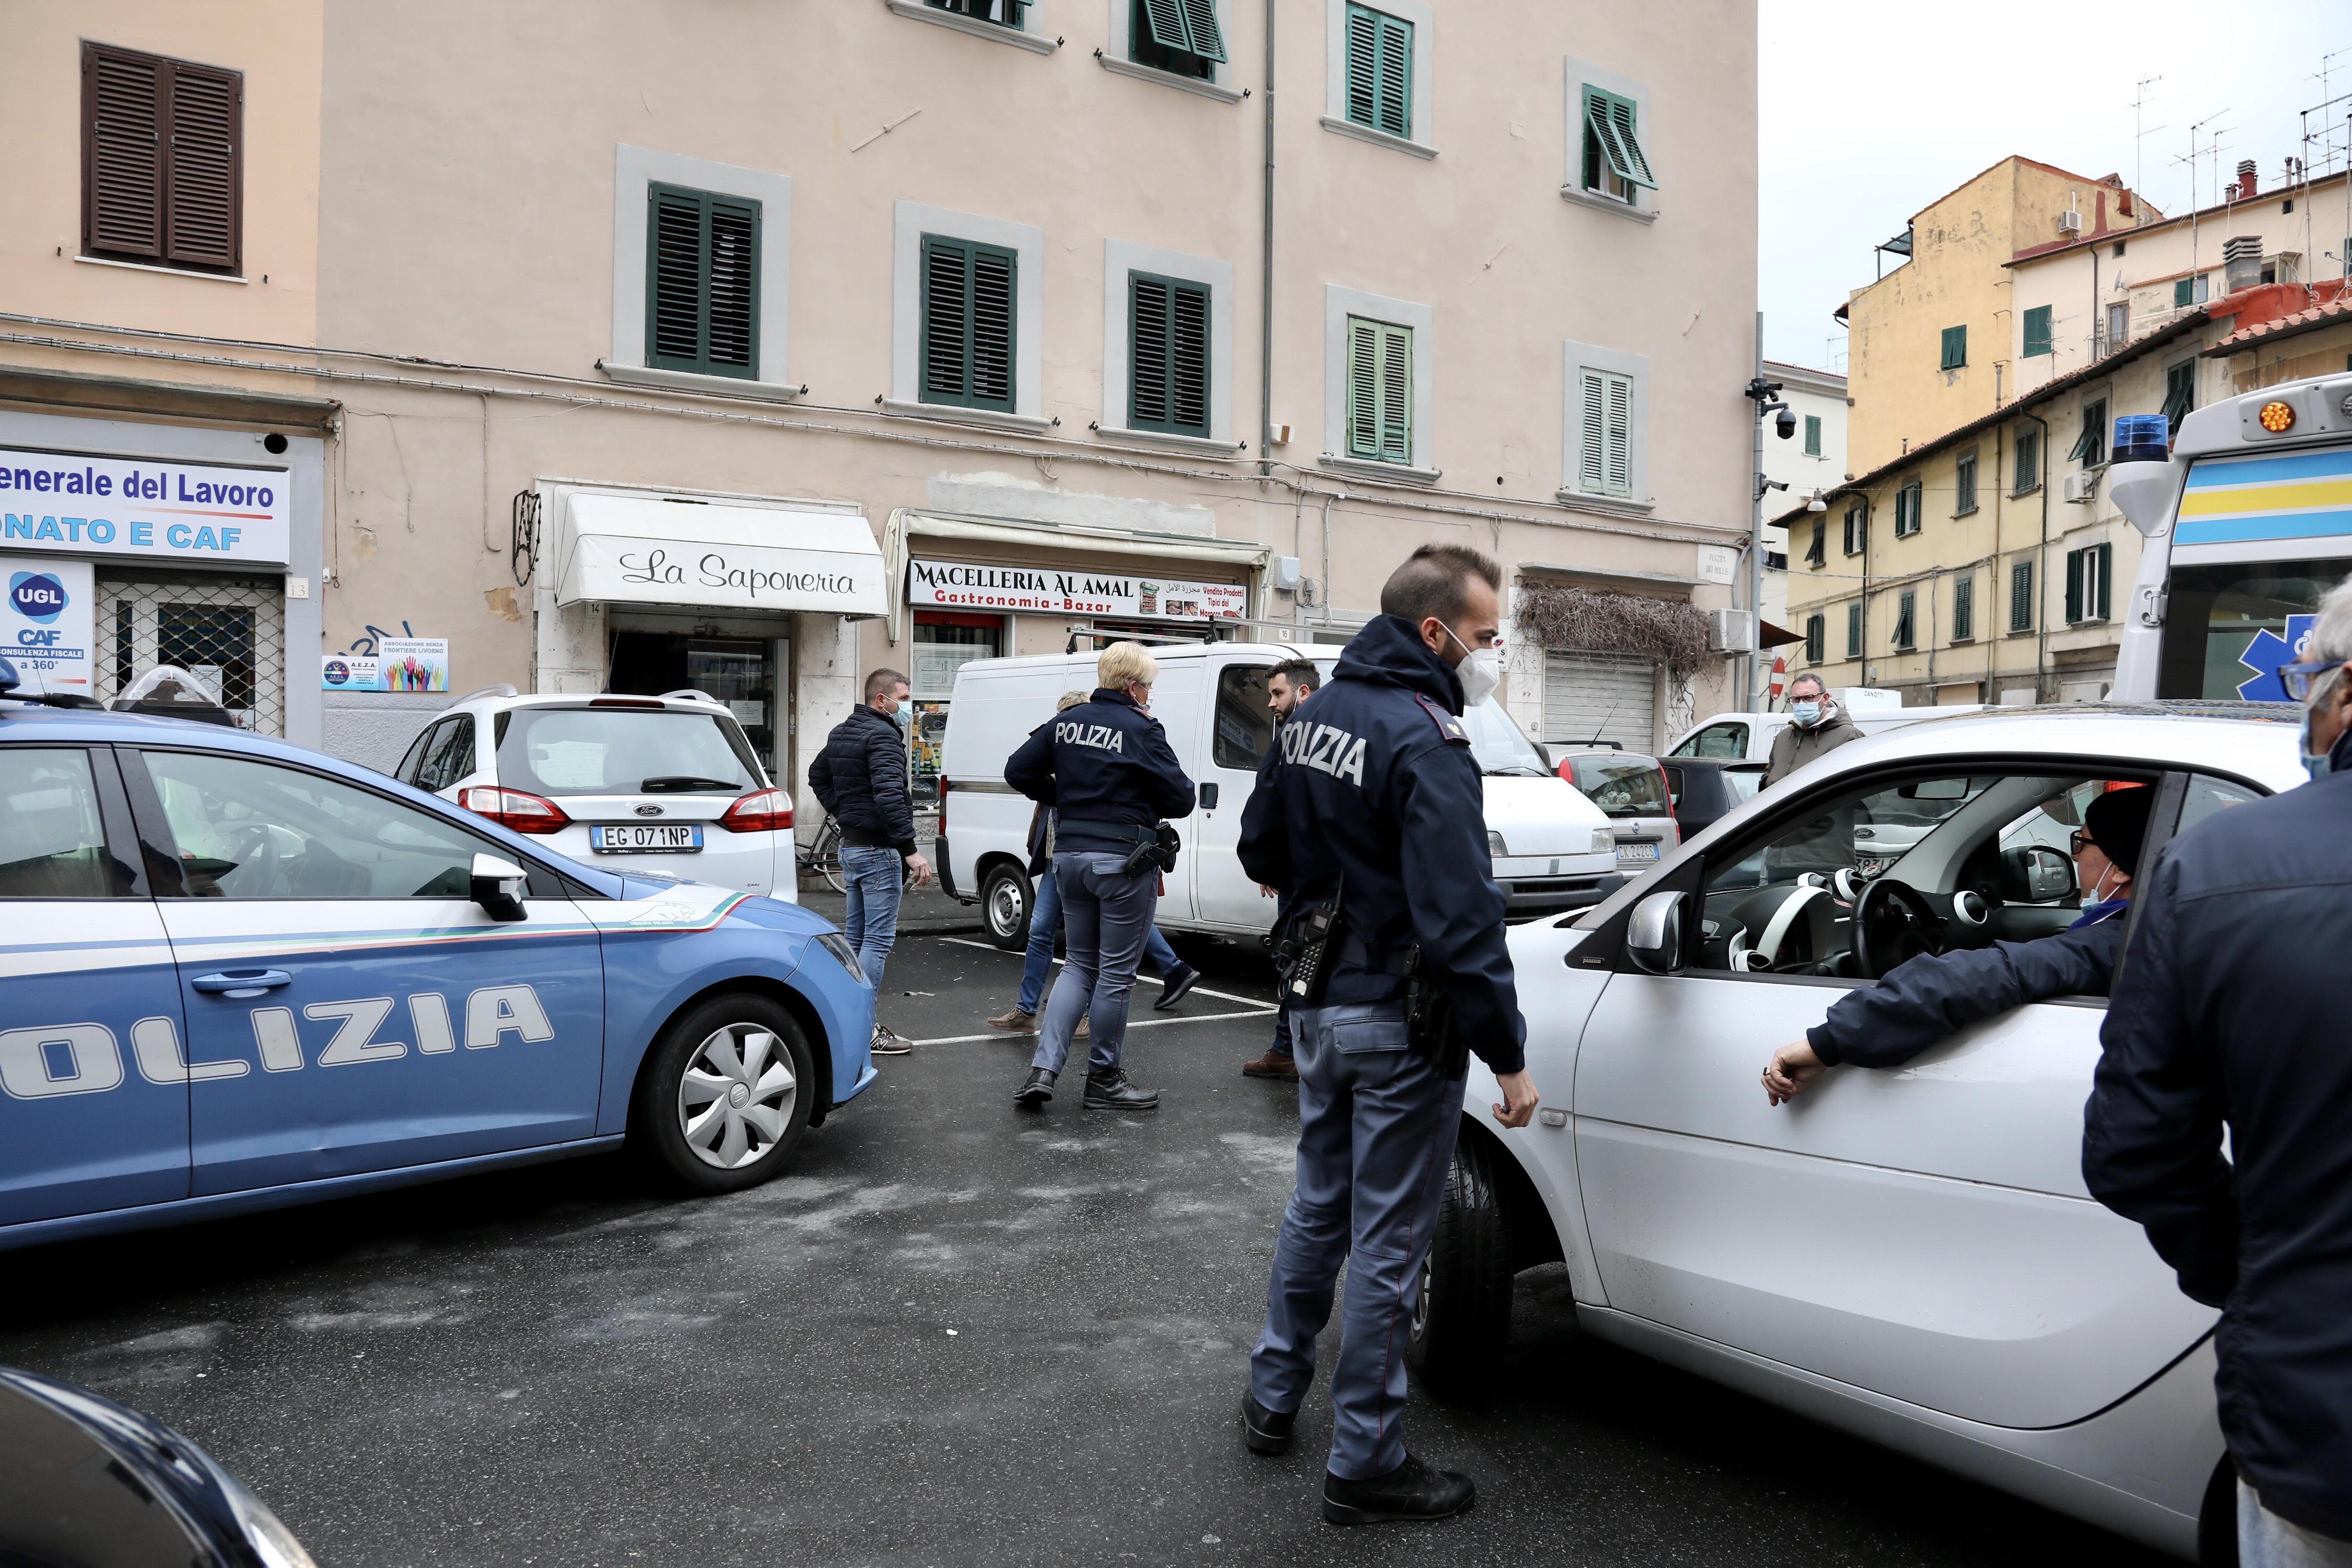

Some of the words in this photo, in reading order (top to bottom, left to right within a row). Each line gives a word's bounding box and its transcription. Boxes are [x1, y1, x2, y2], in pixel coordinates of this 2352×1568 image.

[123, 470, 167, 500] del
[179, 474, 273, 507] Lavoro
[0, 514, 116, 544] NATO
[130, 522, 153, 546] E
[166, 524, 241, 551] CAF
[1709, 554, 1726, 563] PIAZZA
[619, 549, 687, 584] La
[699, 554, 857, 598] Saponeria
[1714, 566, 1729, 575] MILLE
[914, 562, 1046, 591] MACELLERIA
[1082, 577, 1134, 597] AMAL
[290, 584, 306, 596] 13
[1165, 583, 1180, 593] الأمل
[1182, 585, 1200, 594] مجزرة
[1203, 586, 1222, 595] Vendita
[1223, 588, 1244, 597] Prodotti
[18, 588, 61, 604] UGL
[1208, 597, 1221, 607] Tipici
[591, 603, 599, 614] 14
[17, 629, 61, 646] CAF
[0, 648, 49, 656] ONSULENZA
[1864, 690, 1885, 699] ZANOTTI
[1055, 722, 1123, 754] POLIZIA
